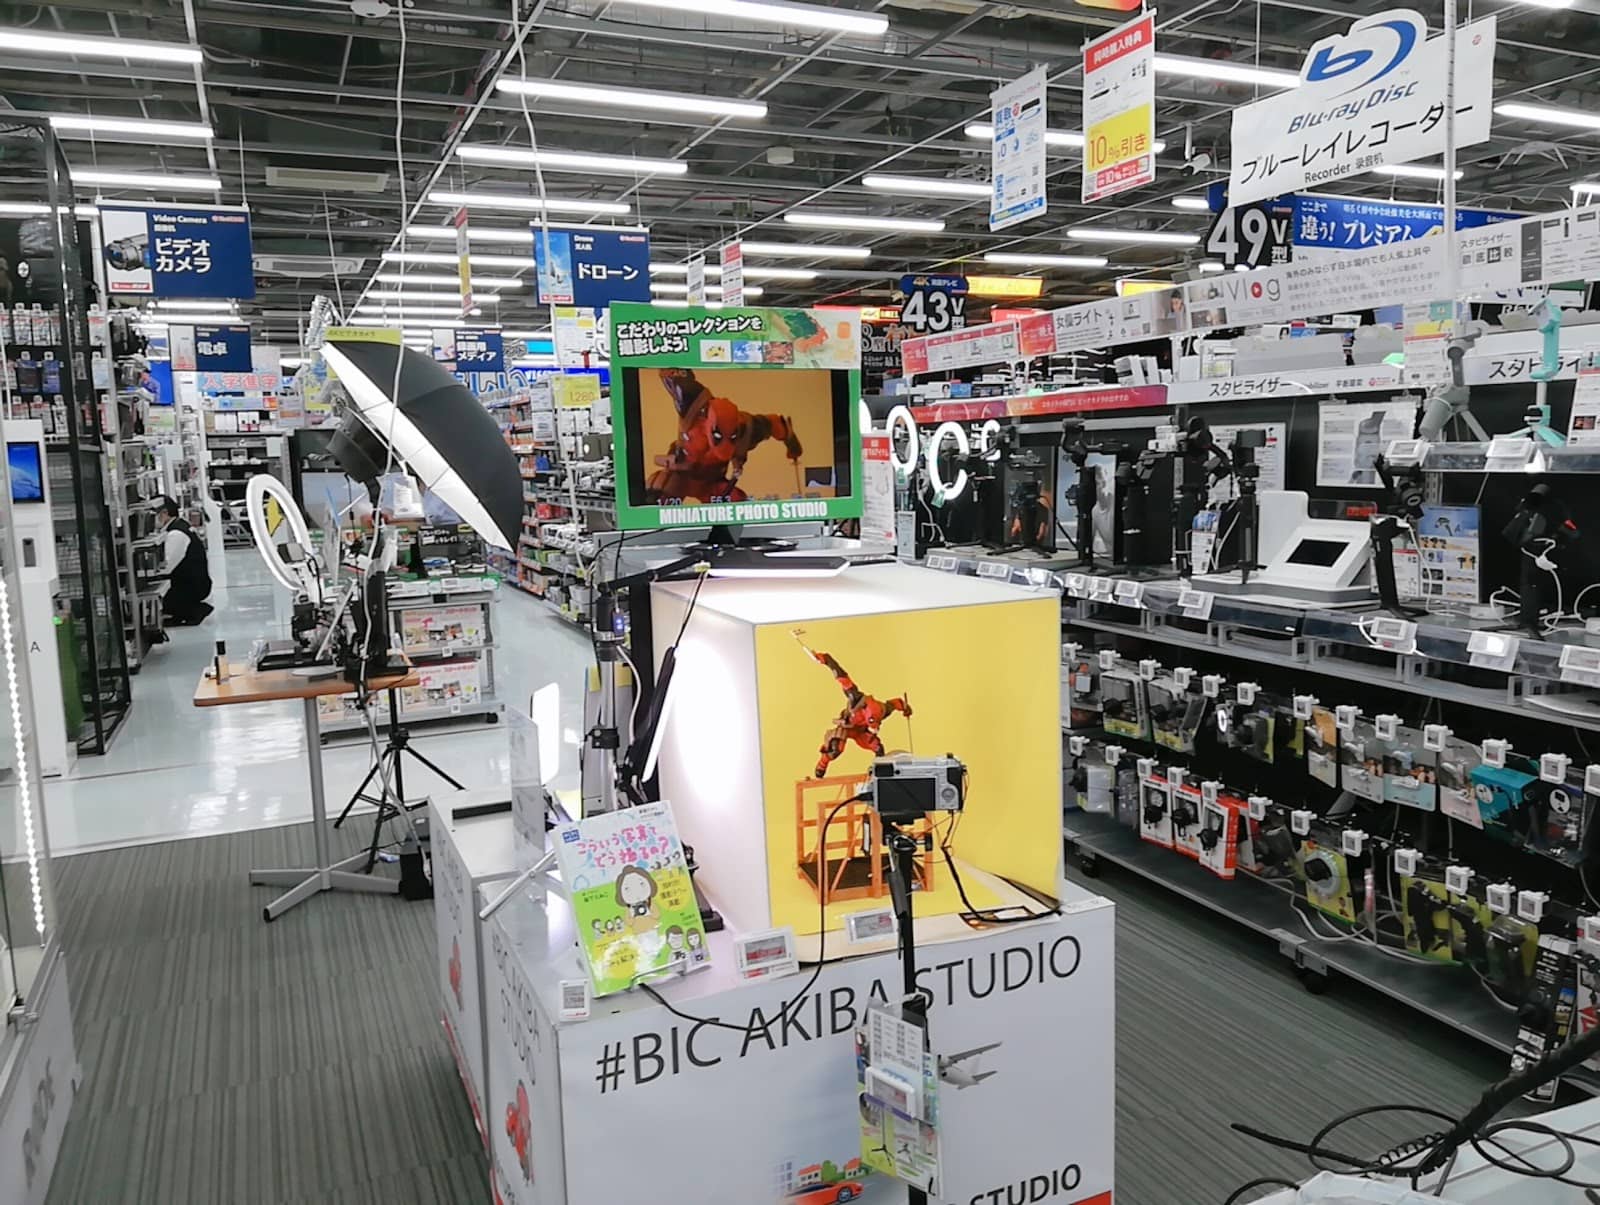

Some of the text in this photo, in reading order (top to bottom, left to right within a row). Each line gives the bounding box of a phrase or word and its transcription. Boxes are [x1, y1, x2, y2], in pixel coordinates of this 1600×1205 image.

[1241, 101, 1473, 184] ブルーレイレコーダー
[1305, 163, 1351, 184] Recorder
[155, 238, 210, 256] ビデオ
[156, 255, 211, 273] カメラ
[578, 262, 639, 280] ドローン
[617, 316, 763, 338] こだわりのコレクションを
[618, 339, 688, 356] 撮影しよう!
[659, 501, 828, 525] MINIATURE PHOTO STUDIO
[739, 979, 890, 1057] AKIBA
[913, 935, 1082, 1012] STUDIO
